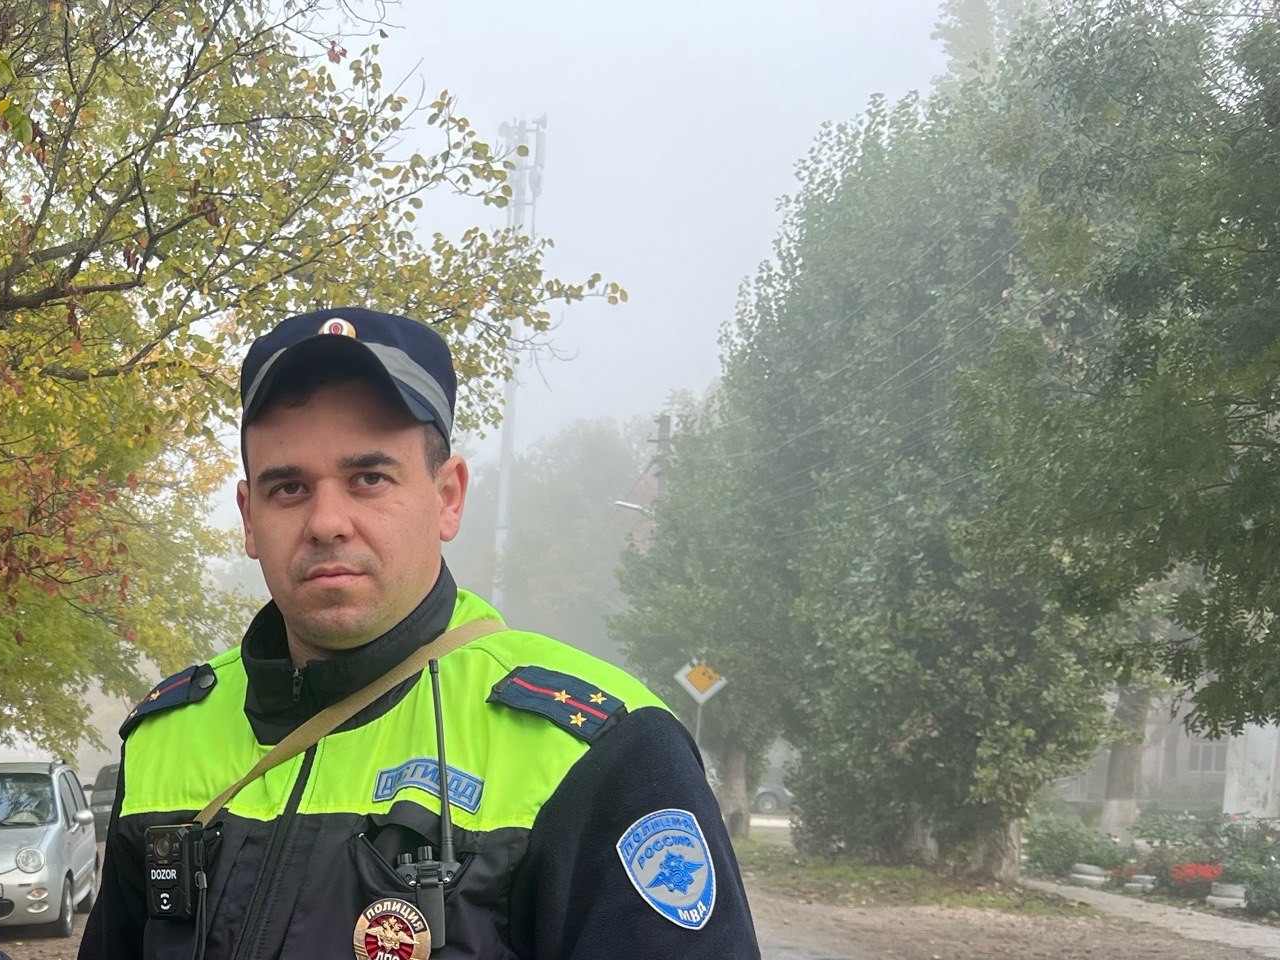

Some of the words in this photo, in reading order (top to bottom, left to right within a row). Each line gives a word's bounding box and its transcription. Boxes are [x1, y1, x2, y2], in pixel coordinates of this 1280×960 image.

[624, 817, 694, 857] ПОЛИЦИЯ
[637, 836, 696, 870] РОССИЯ
[150, 869, 177, 880] DOZOR
[366, 902, 423, 932] ПОЛИЦИЯ
[677, 900, 707, 923] МВД
